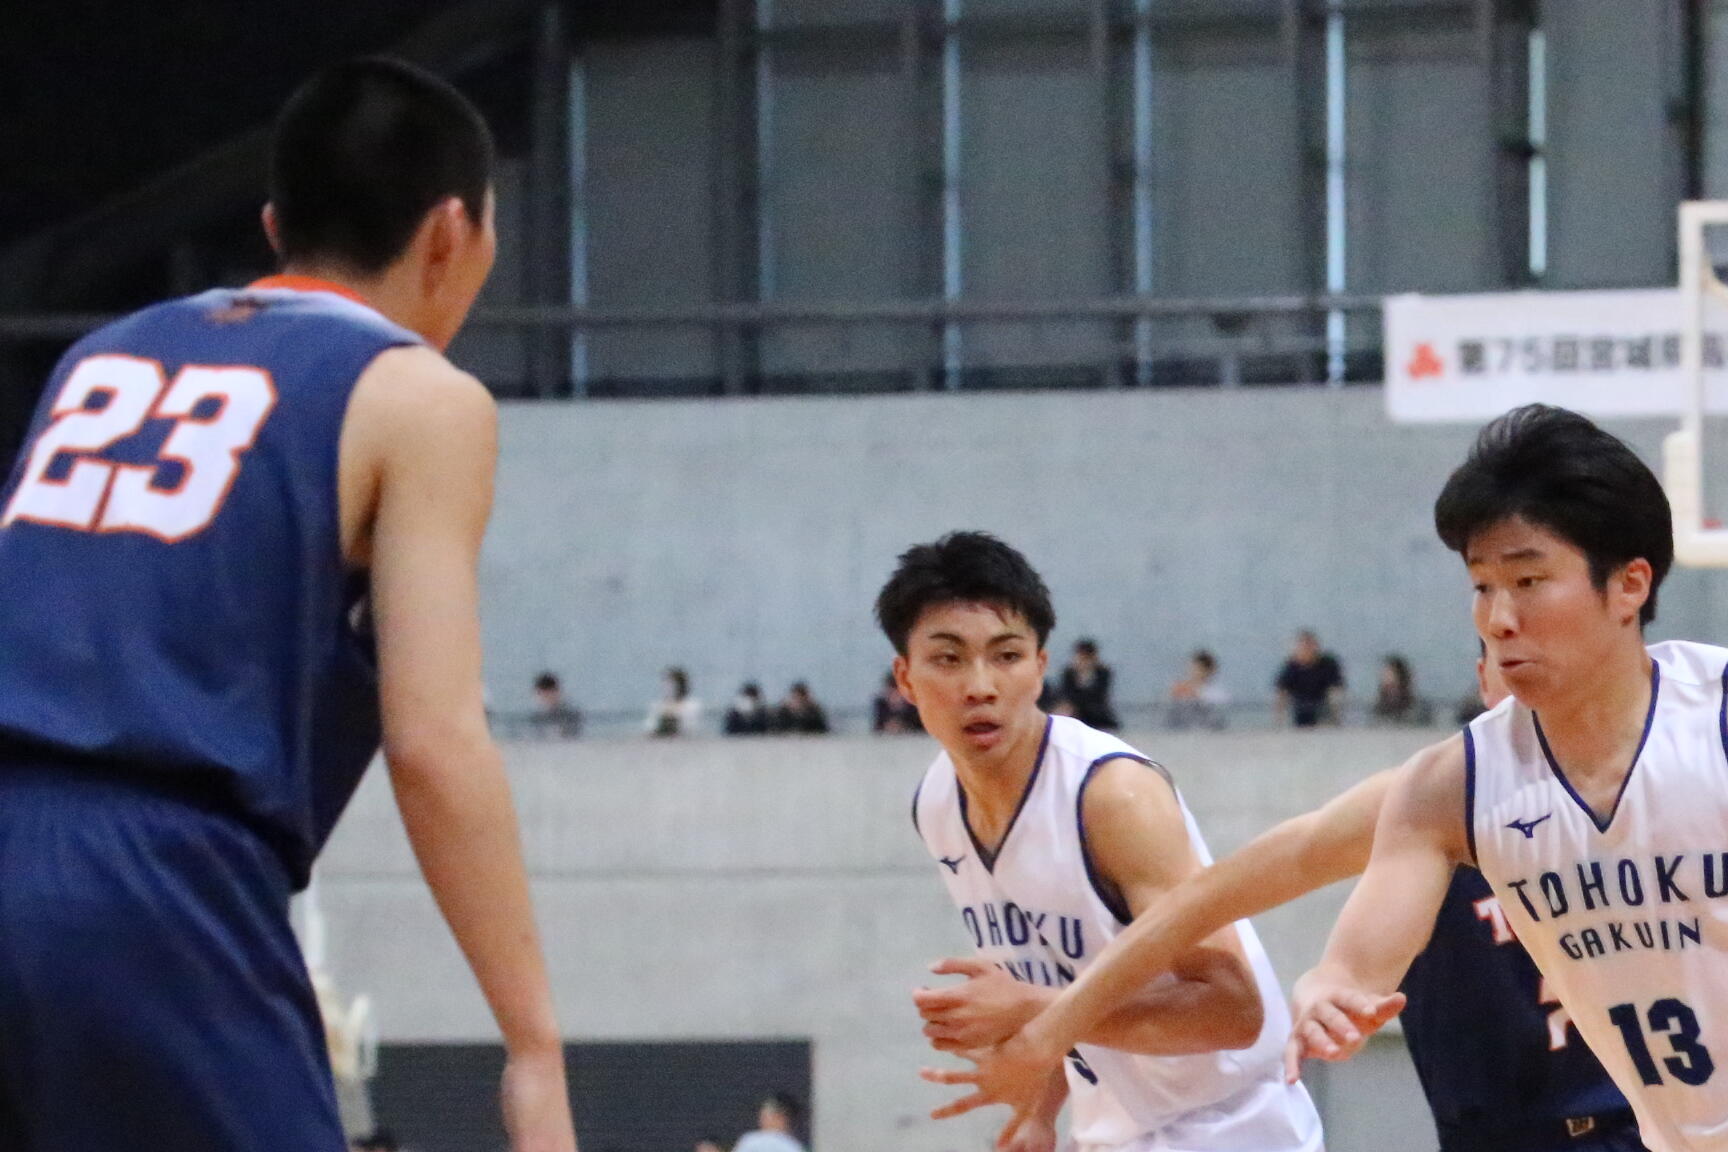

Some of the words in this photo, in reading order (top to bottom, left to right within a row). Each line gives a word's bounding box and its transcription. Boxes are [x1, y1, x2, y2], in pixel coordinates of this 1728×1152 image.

[0, 353, 278, 544] 23
[962, 901, 1084, 959] OHOKU
[1558, 916, 1702, 961] GAKUIN
[1607, 997, 1716, 1086] 13
